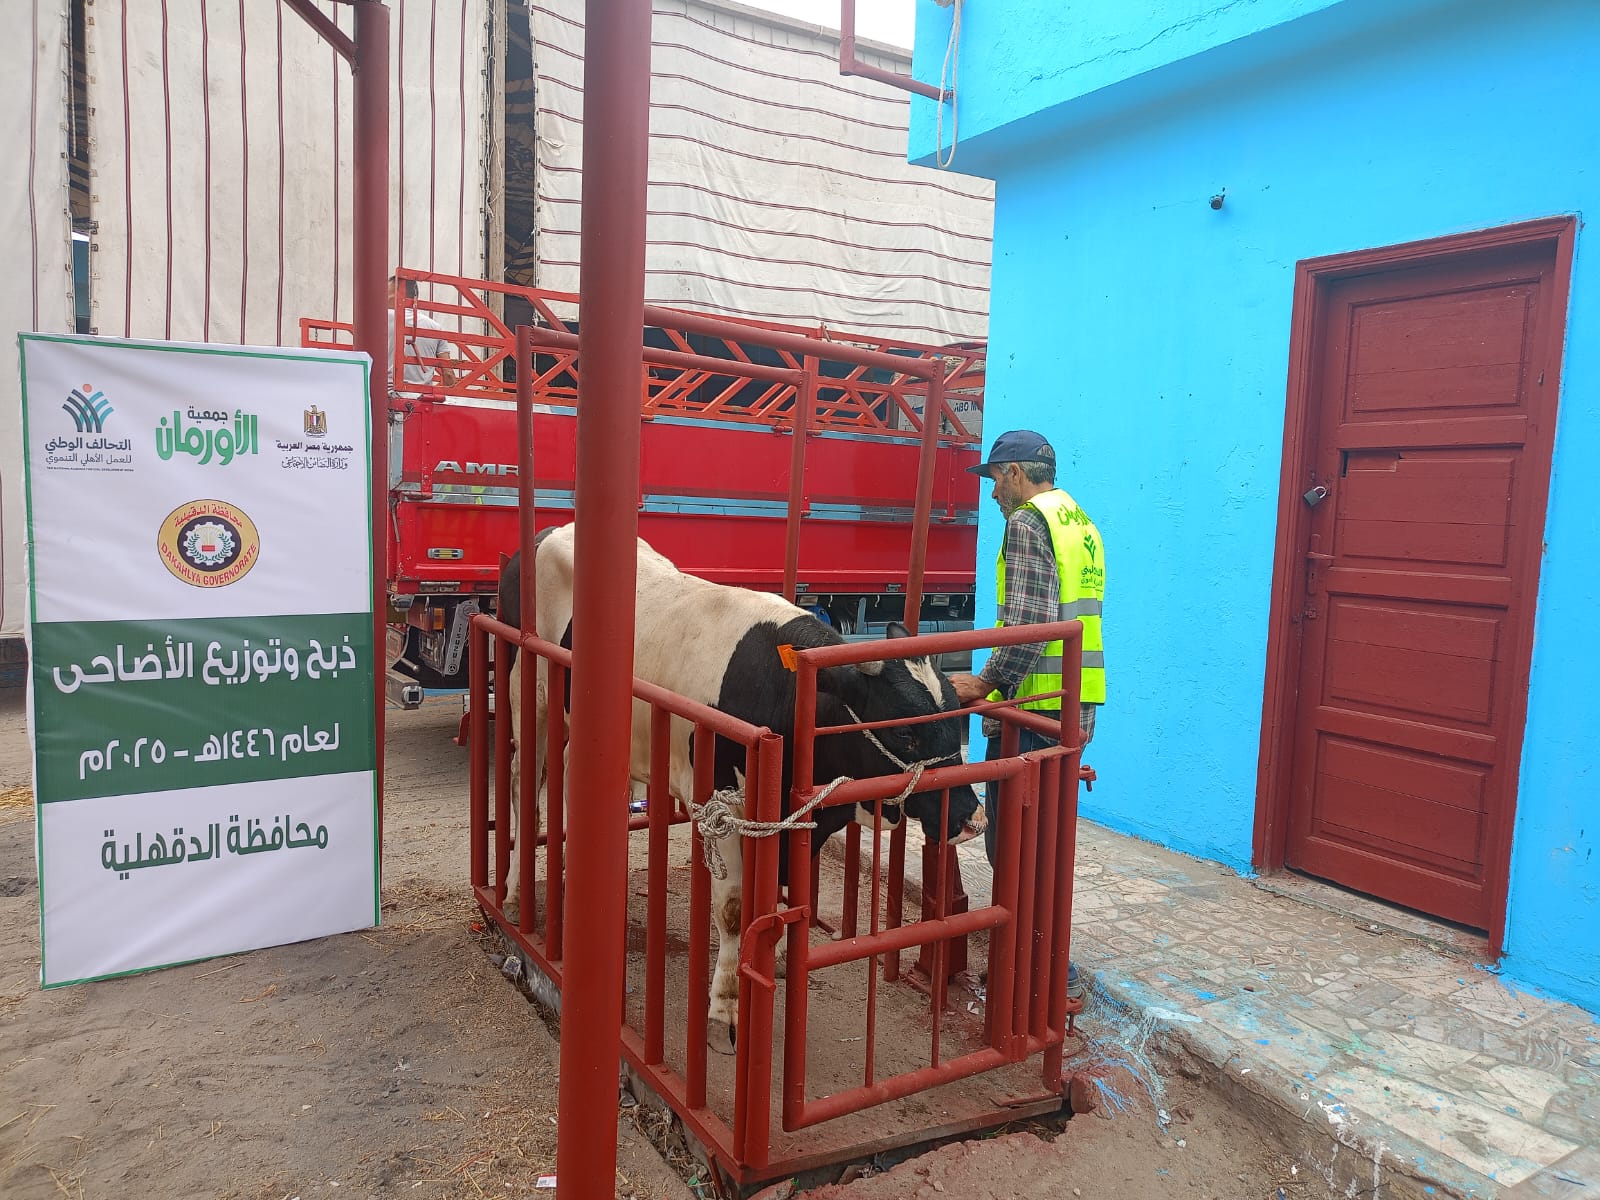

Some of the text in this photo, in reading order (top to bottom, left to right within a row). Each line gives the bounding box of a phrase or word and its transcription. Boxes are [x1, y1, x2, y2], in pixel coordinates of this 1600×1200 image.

[187, 405, 228, 425] جمعية
[44, 436, 132, 455] التحالف الوطني
[155, 408, 259, 466] الأورمان
[275, 439, 354, 454] جمهورية مصر العربية
[45, 452, 132, 467] للعمل الأهلي التنموي
[172, 503, 243, 529] محافظة الدقهلية
[161, 542, 257, 586] DAKAHLYA GOVERNORATE
[53, 634, 357, 694] ذبح وتوزيع الأضاحى
[79, 737, 167, 781] ٢٠٢٥م
[281, 722, 340, 762] لعام
[101, 814, 329, 881] محافظة الدقهلية
